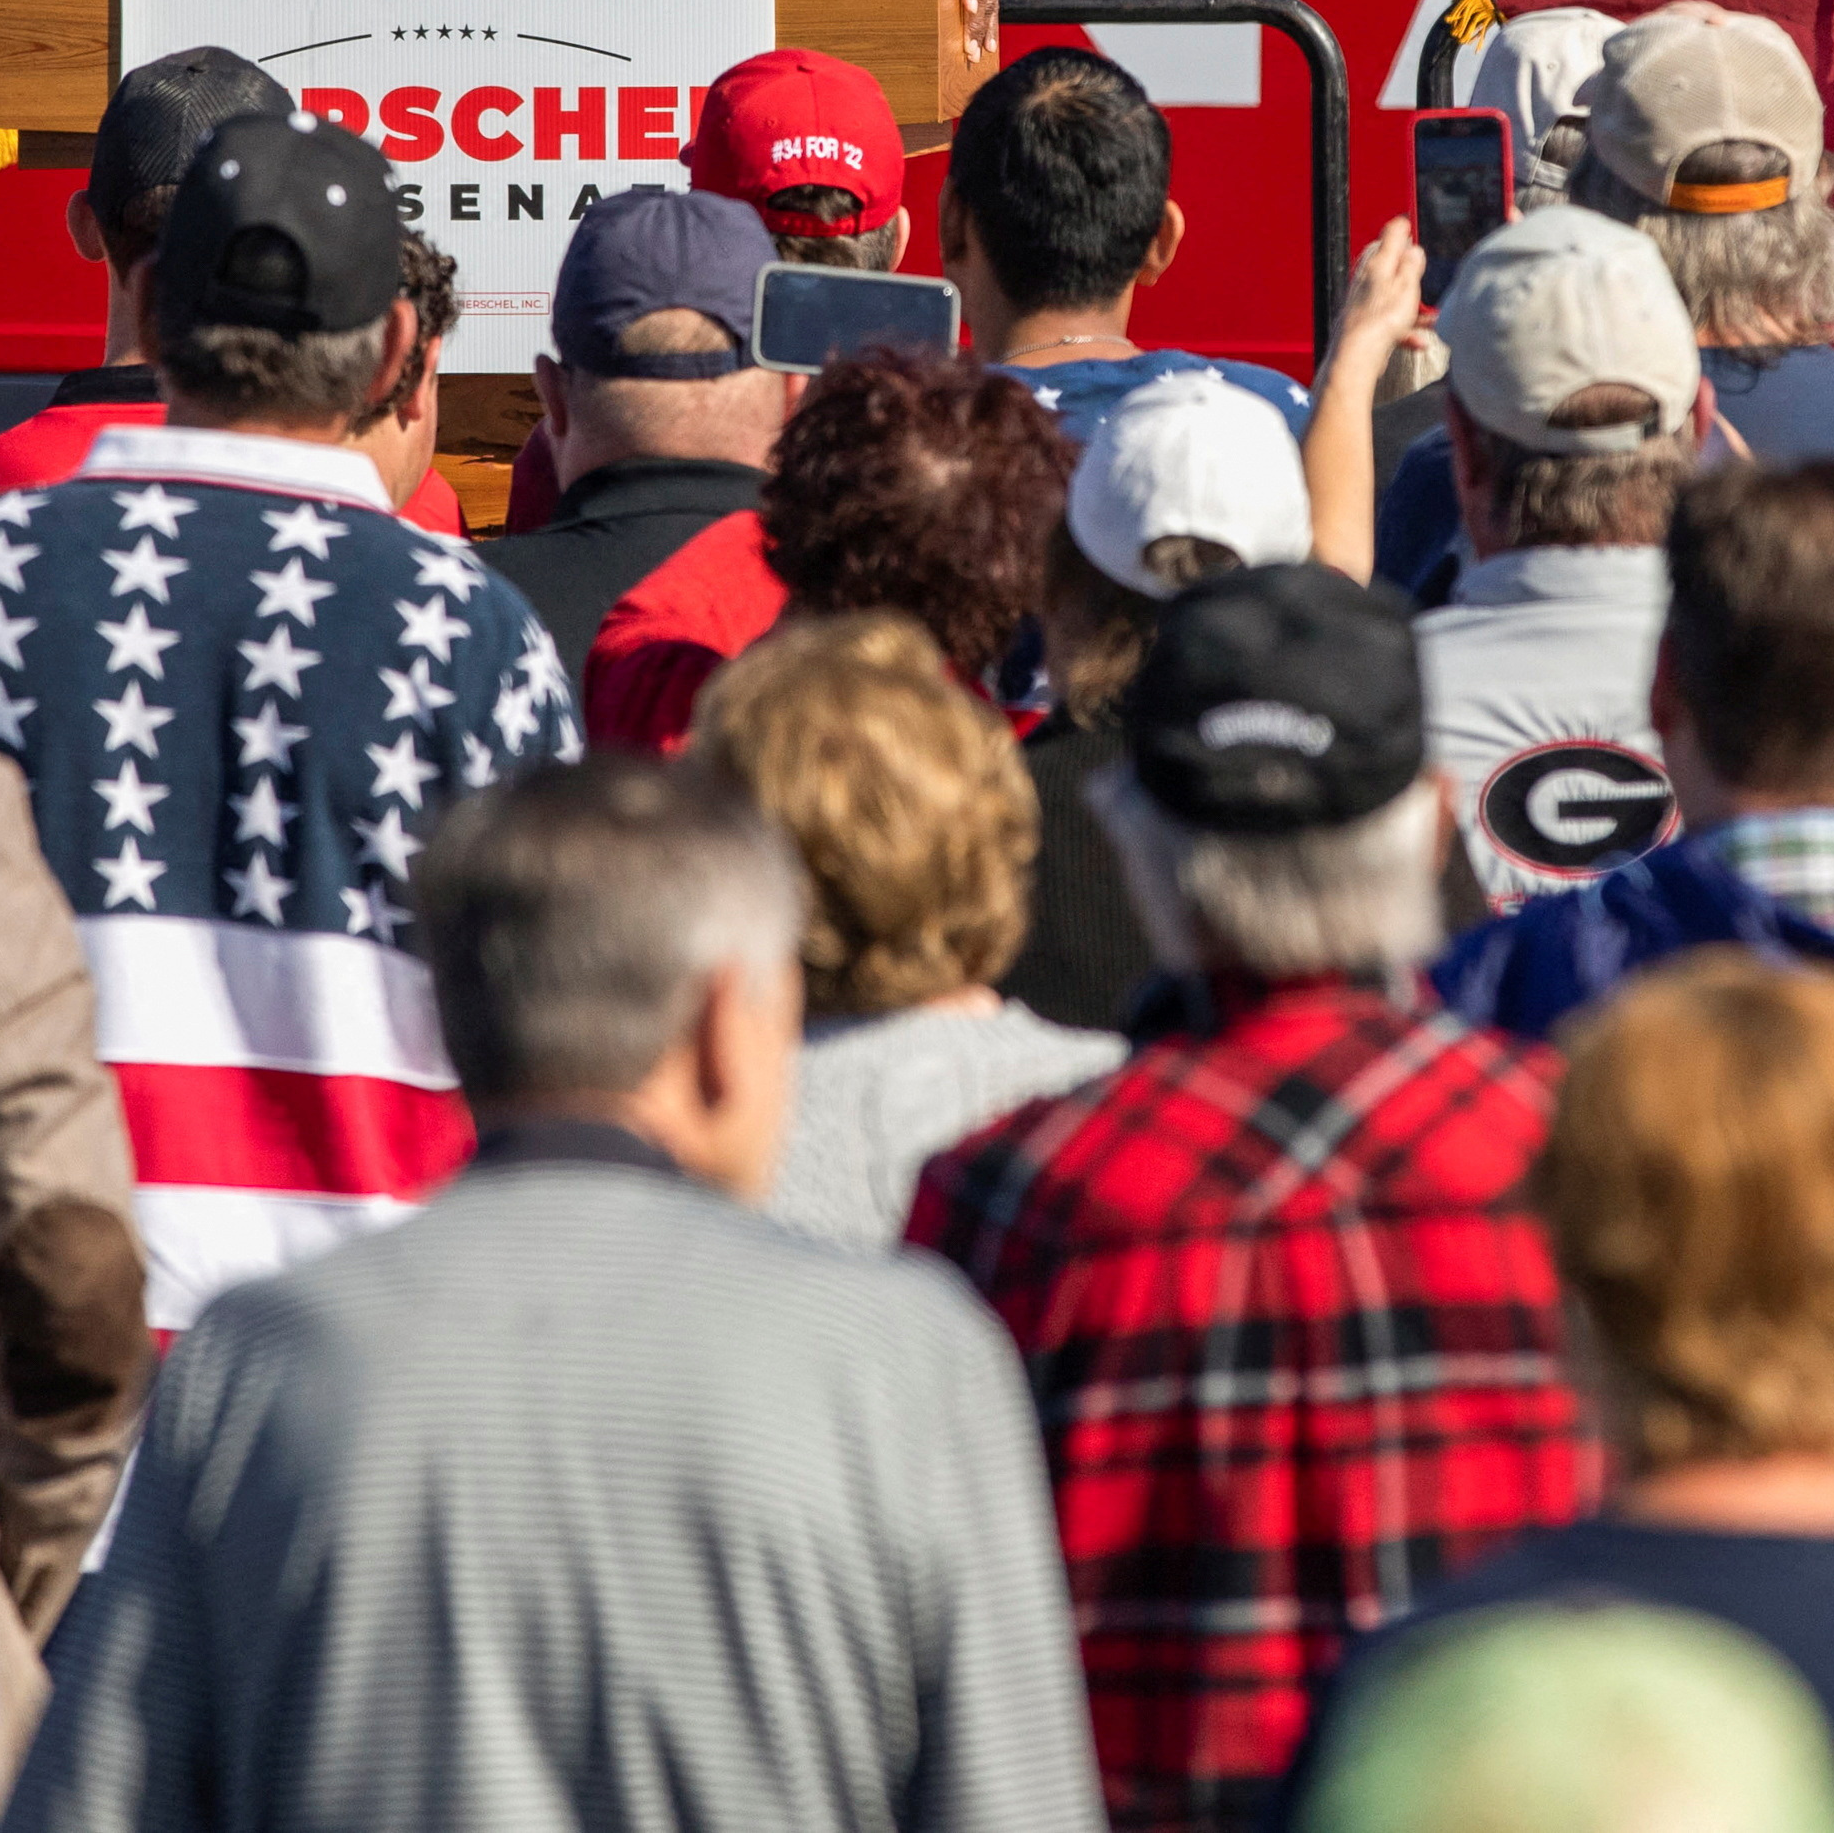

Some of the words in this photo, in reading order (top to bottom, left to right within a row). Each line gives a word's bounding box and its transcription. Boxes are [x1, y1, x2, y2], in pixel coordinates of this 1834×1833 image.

[771, 136, 803, 164] #34
[805, 135, 840, 161] FOR
[842, 141, 864, 171] '22
[396, 183, 666, 222] SENA
[521, 299, 544, 309] INC.
[1525, 768, 1667, 846] G
